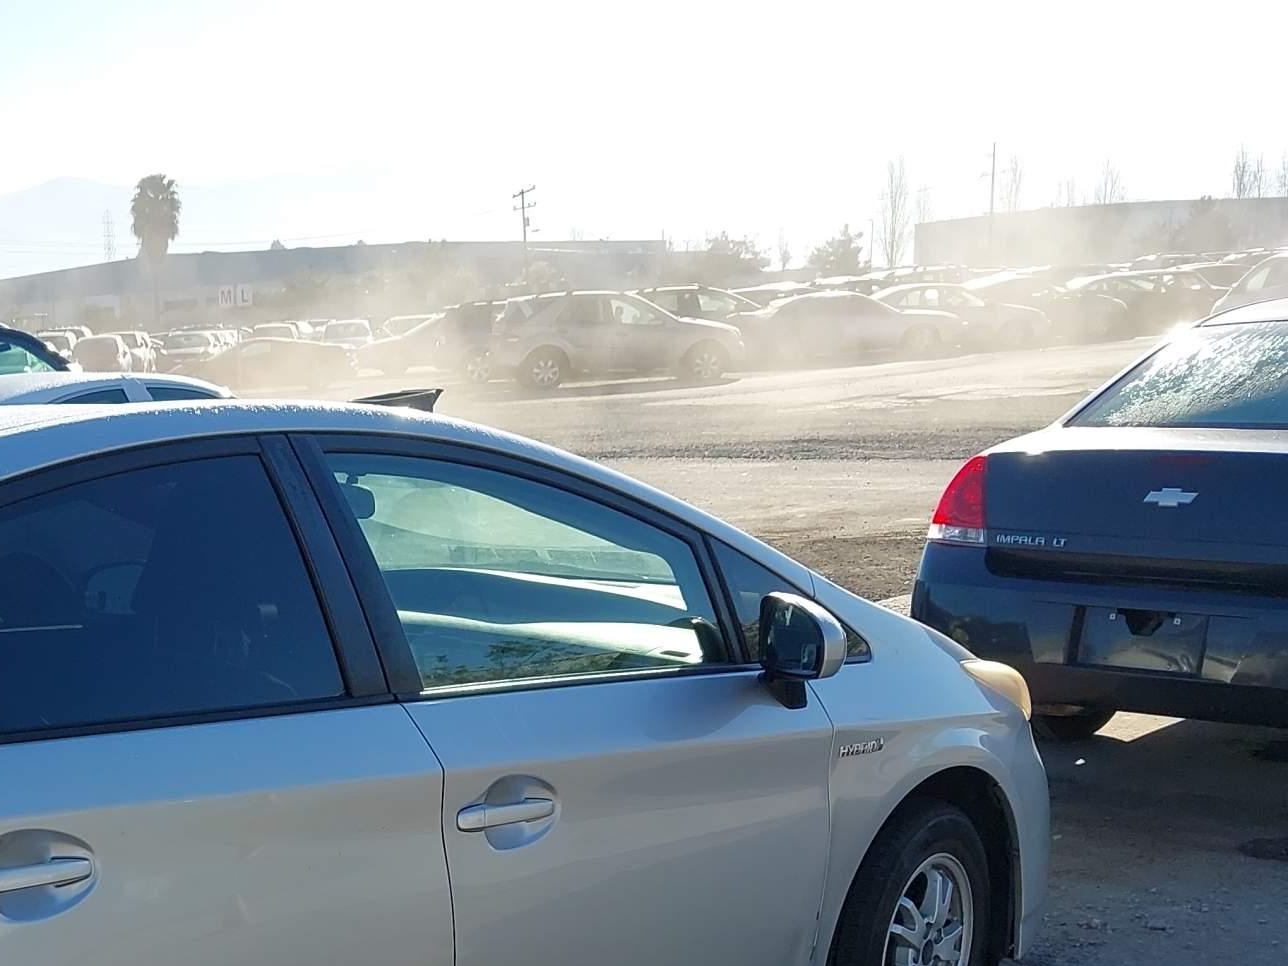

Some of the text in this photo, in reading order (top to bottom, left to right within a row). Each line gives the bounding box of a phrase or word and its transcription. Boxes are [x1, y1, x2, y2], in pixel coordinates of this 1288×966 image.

[220, 288, 249, 305] M L
[996, 533, 1067, 547] IMPALA LT
[839, 737, 884, 758] HYBRID
